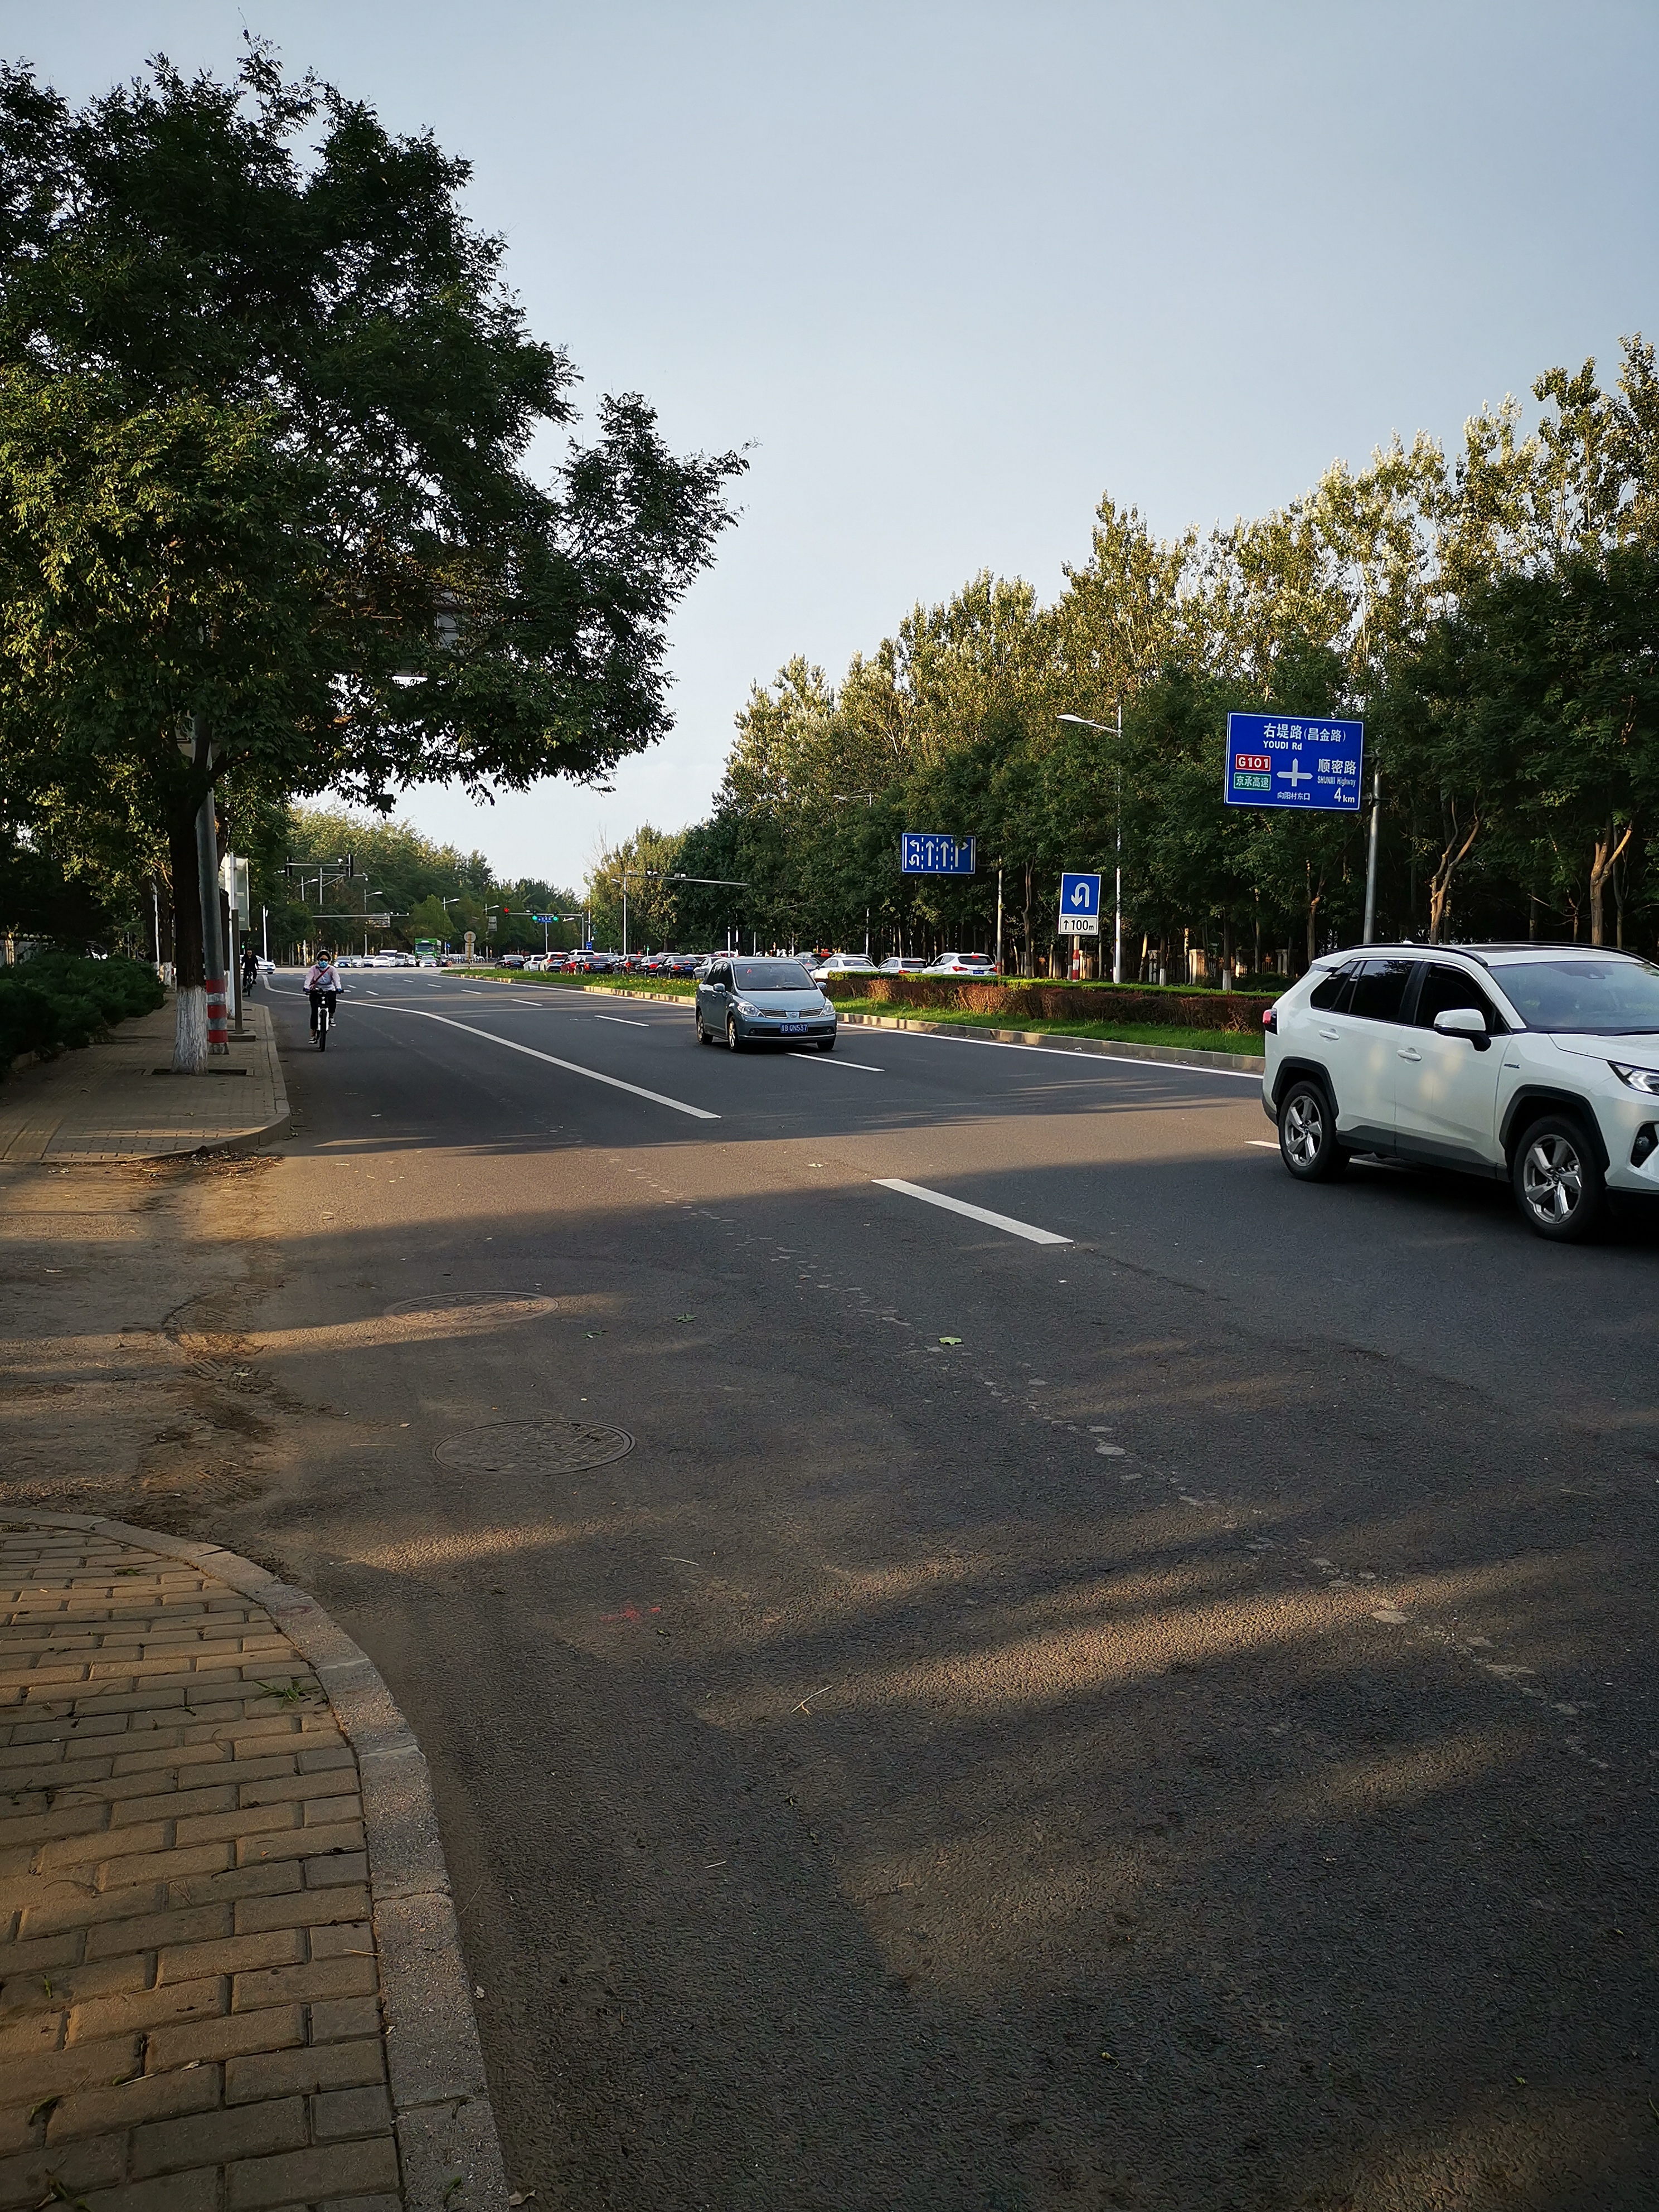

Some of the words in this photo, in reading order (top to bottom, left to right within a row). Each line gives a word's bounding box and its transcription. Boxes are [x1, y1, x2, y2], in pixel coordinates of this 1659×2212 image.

[1263, 740, 1288, 749] YOUDI
[1292, 742, 1302, 750] Rd
[1238, 756, 1269, 769] G101
[1317, 758, 1356, 775] 顺密路
[1236, 775, 1269, 788] 京承高速
[1337, 777, 1356, 788] Highway
[1277, 792, 1311, 801] 向阳村东口
